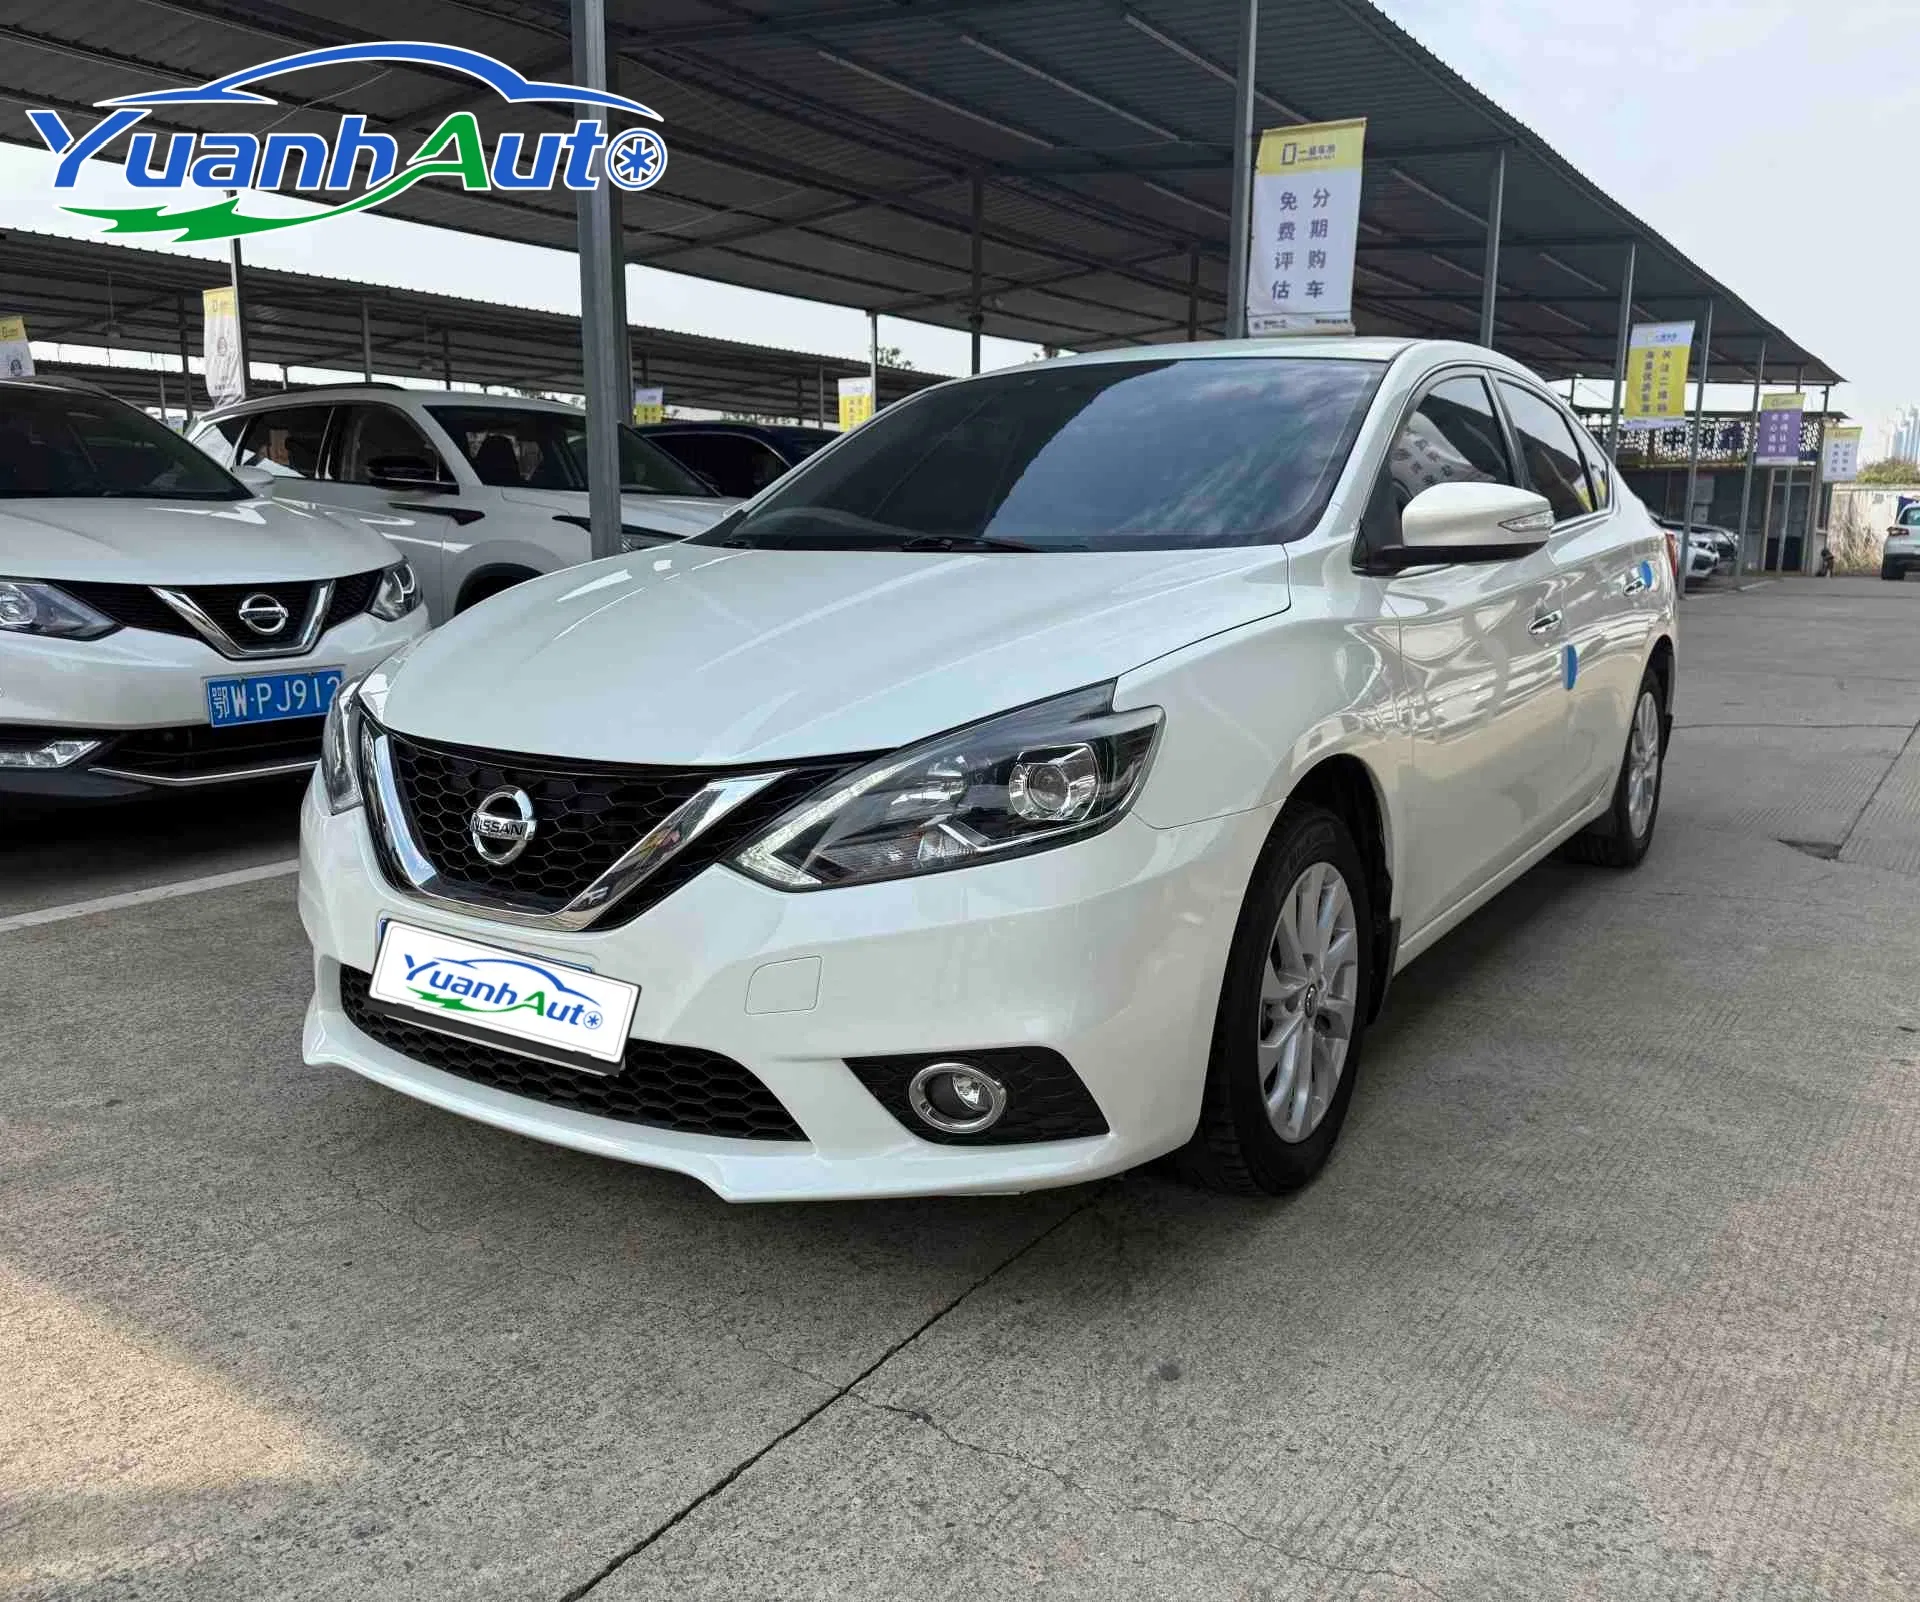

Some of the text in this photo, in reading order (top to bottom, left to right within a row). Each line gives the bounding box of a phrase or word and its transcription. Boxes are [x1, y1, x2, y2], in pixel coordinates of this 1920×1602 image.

[1272, 191, 1298, 300] 免费评估
[1305, 188, 1331, 298] 分期购车
[472, 816, 524, 836] NISSAN
